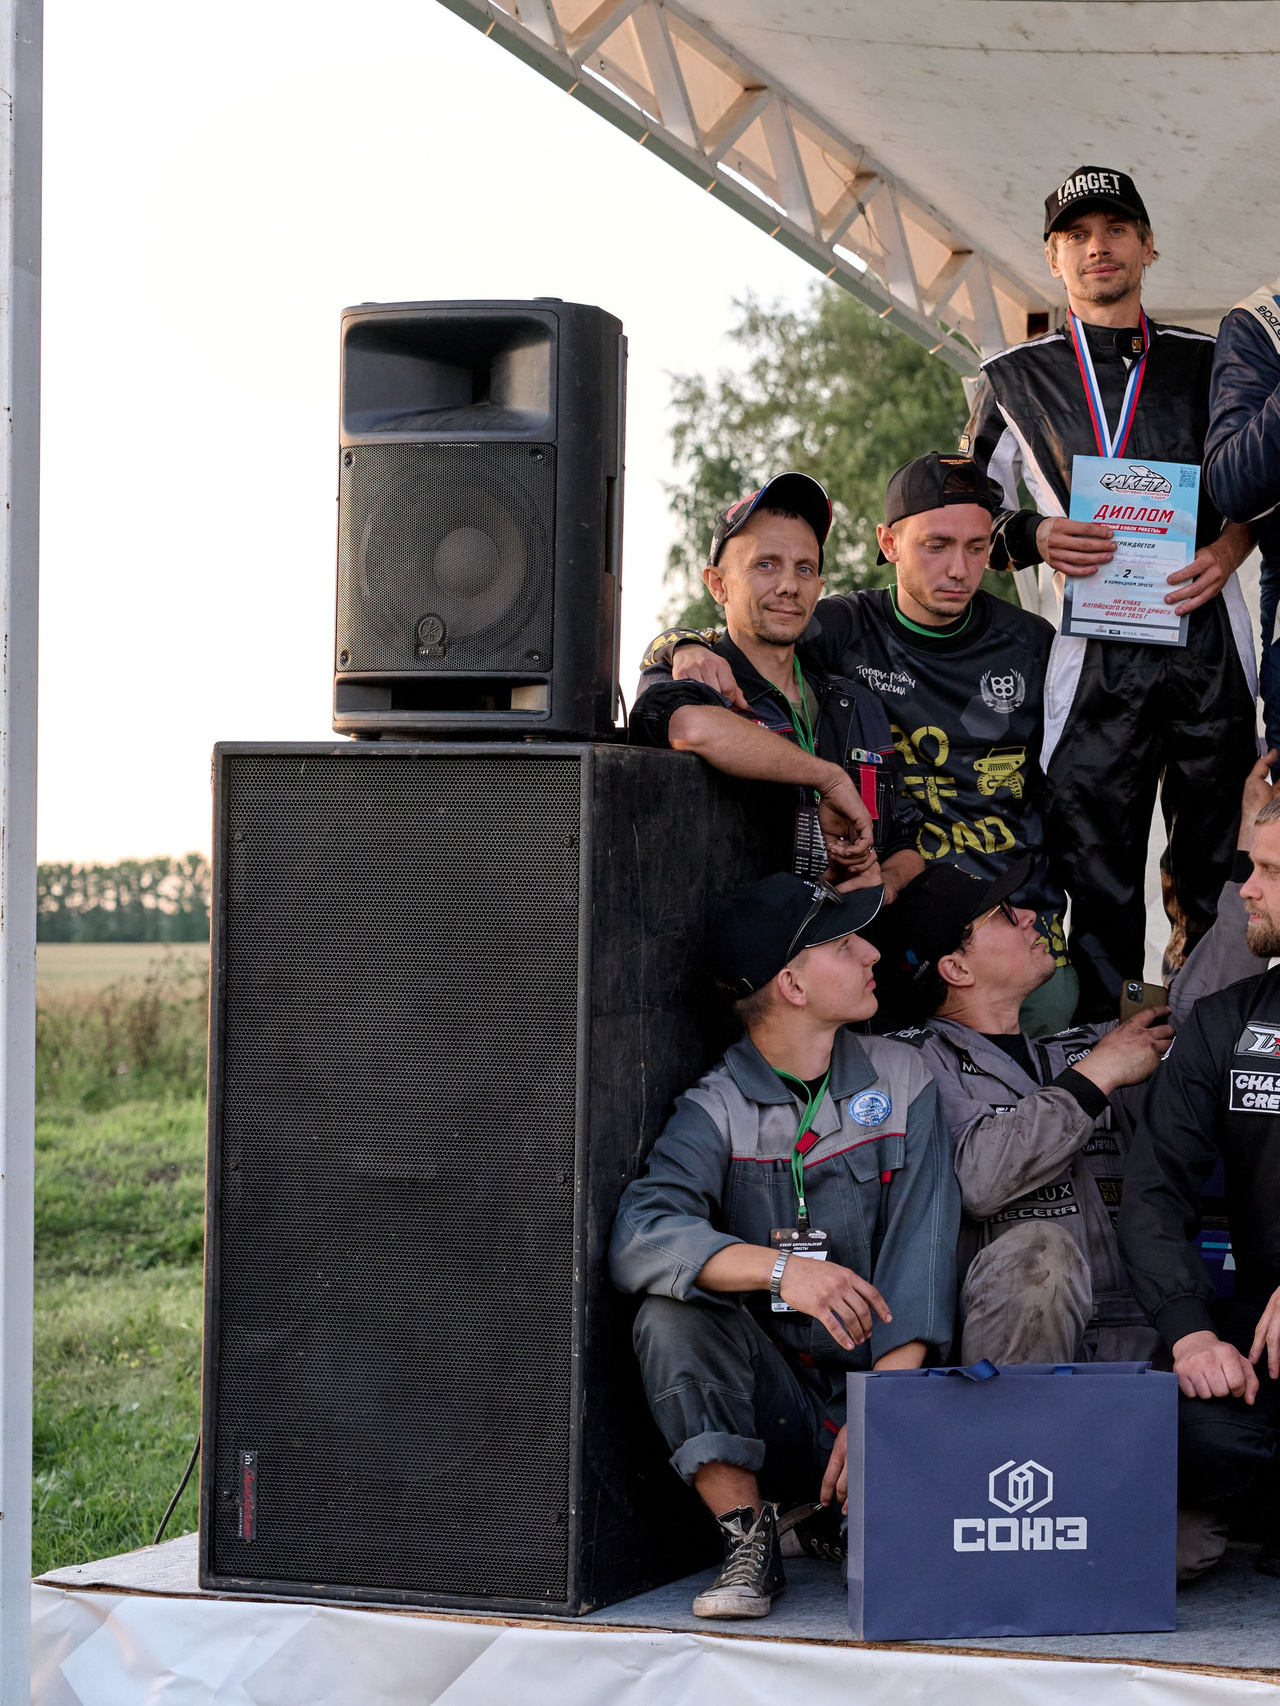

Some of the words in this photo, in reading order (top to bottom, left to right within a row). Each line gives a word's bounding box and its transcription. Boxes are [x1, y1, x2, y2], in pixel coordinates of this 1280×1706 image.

[1057, 172, 1120, 201] TARGET
[1100, 473, 1173, 494] РАКЕТА
[1093, 504, 1175, 523] ДИПЛОМ
[1122, 569, 1131, 578] 2
[953, 1516, 1088, 1552] СОЮЗ
